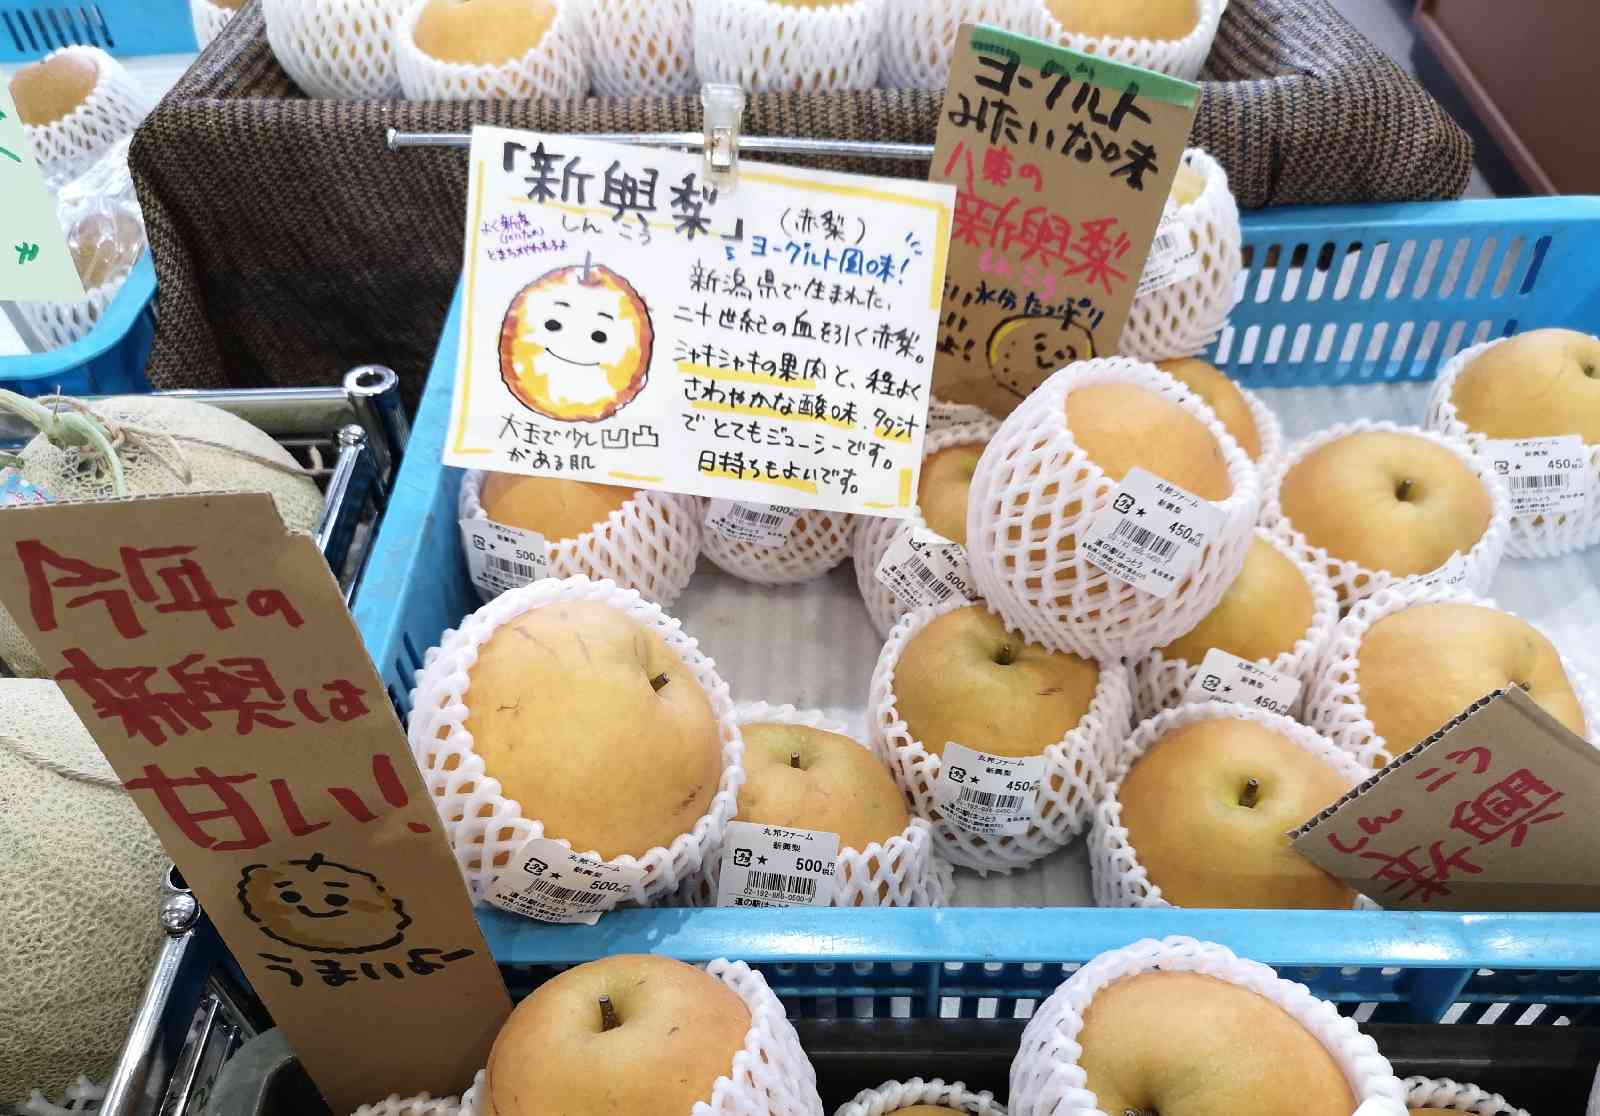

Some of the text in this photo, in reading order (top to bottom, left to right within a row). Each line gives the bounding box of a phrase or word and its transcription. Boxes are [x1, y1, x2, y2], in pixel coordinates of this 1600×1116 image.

[974, 53, 1151, 132] ヨーグルト
[949, 92, 1159, 192] みたいな味
[507, 447, 596, 471] がある肌
[1547, 459, 1570, 469] 450
[698, 449, 858, 495] 日持ちもよいです。
[769, 504, 791, 514] 500
[1169, 521, 1193, 540] 450
[515, 549, 536, 562] 500
[16, 540, 305, 639] 今年の
[944, 571, 966, 590] 500
[1254, 695, 1278, 711] 450
[1006, 781, 1030, 791] 450
[125, 753, 432, 851] 甘い!
[796, 857, 822, 873] 500
[590, 880, 617, 892] 500
